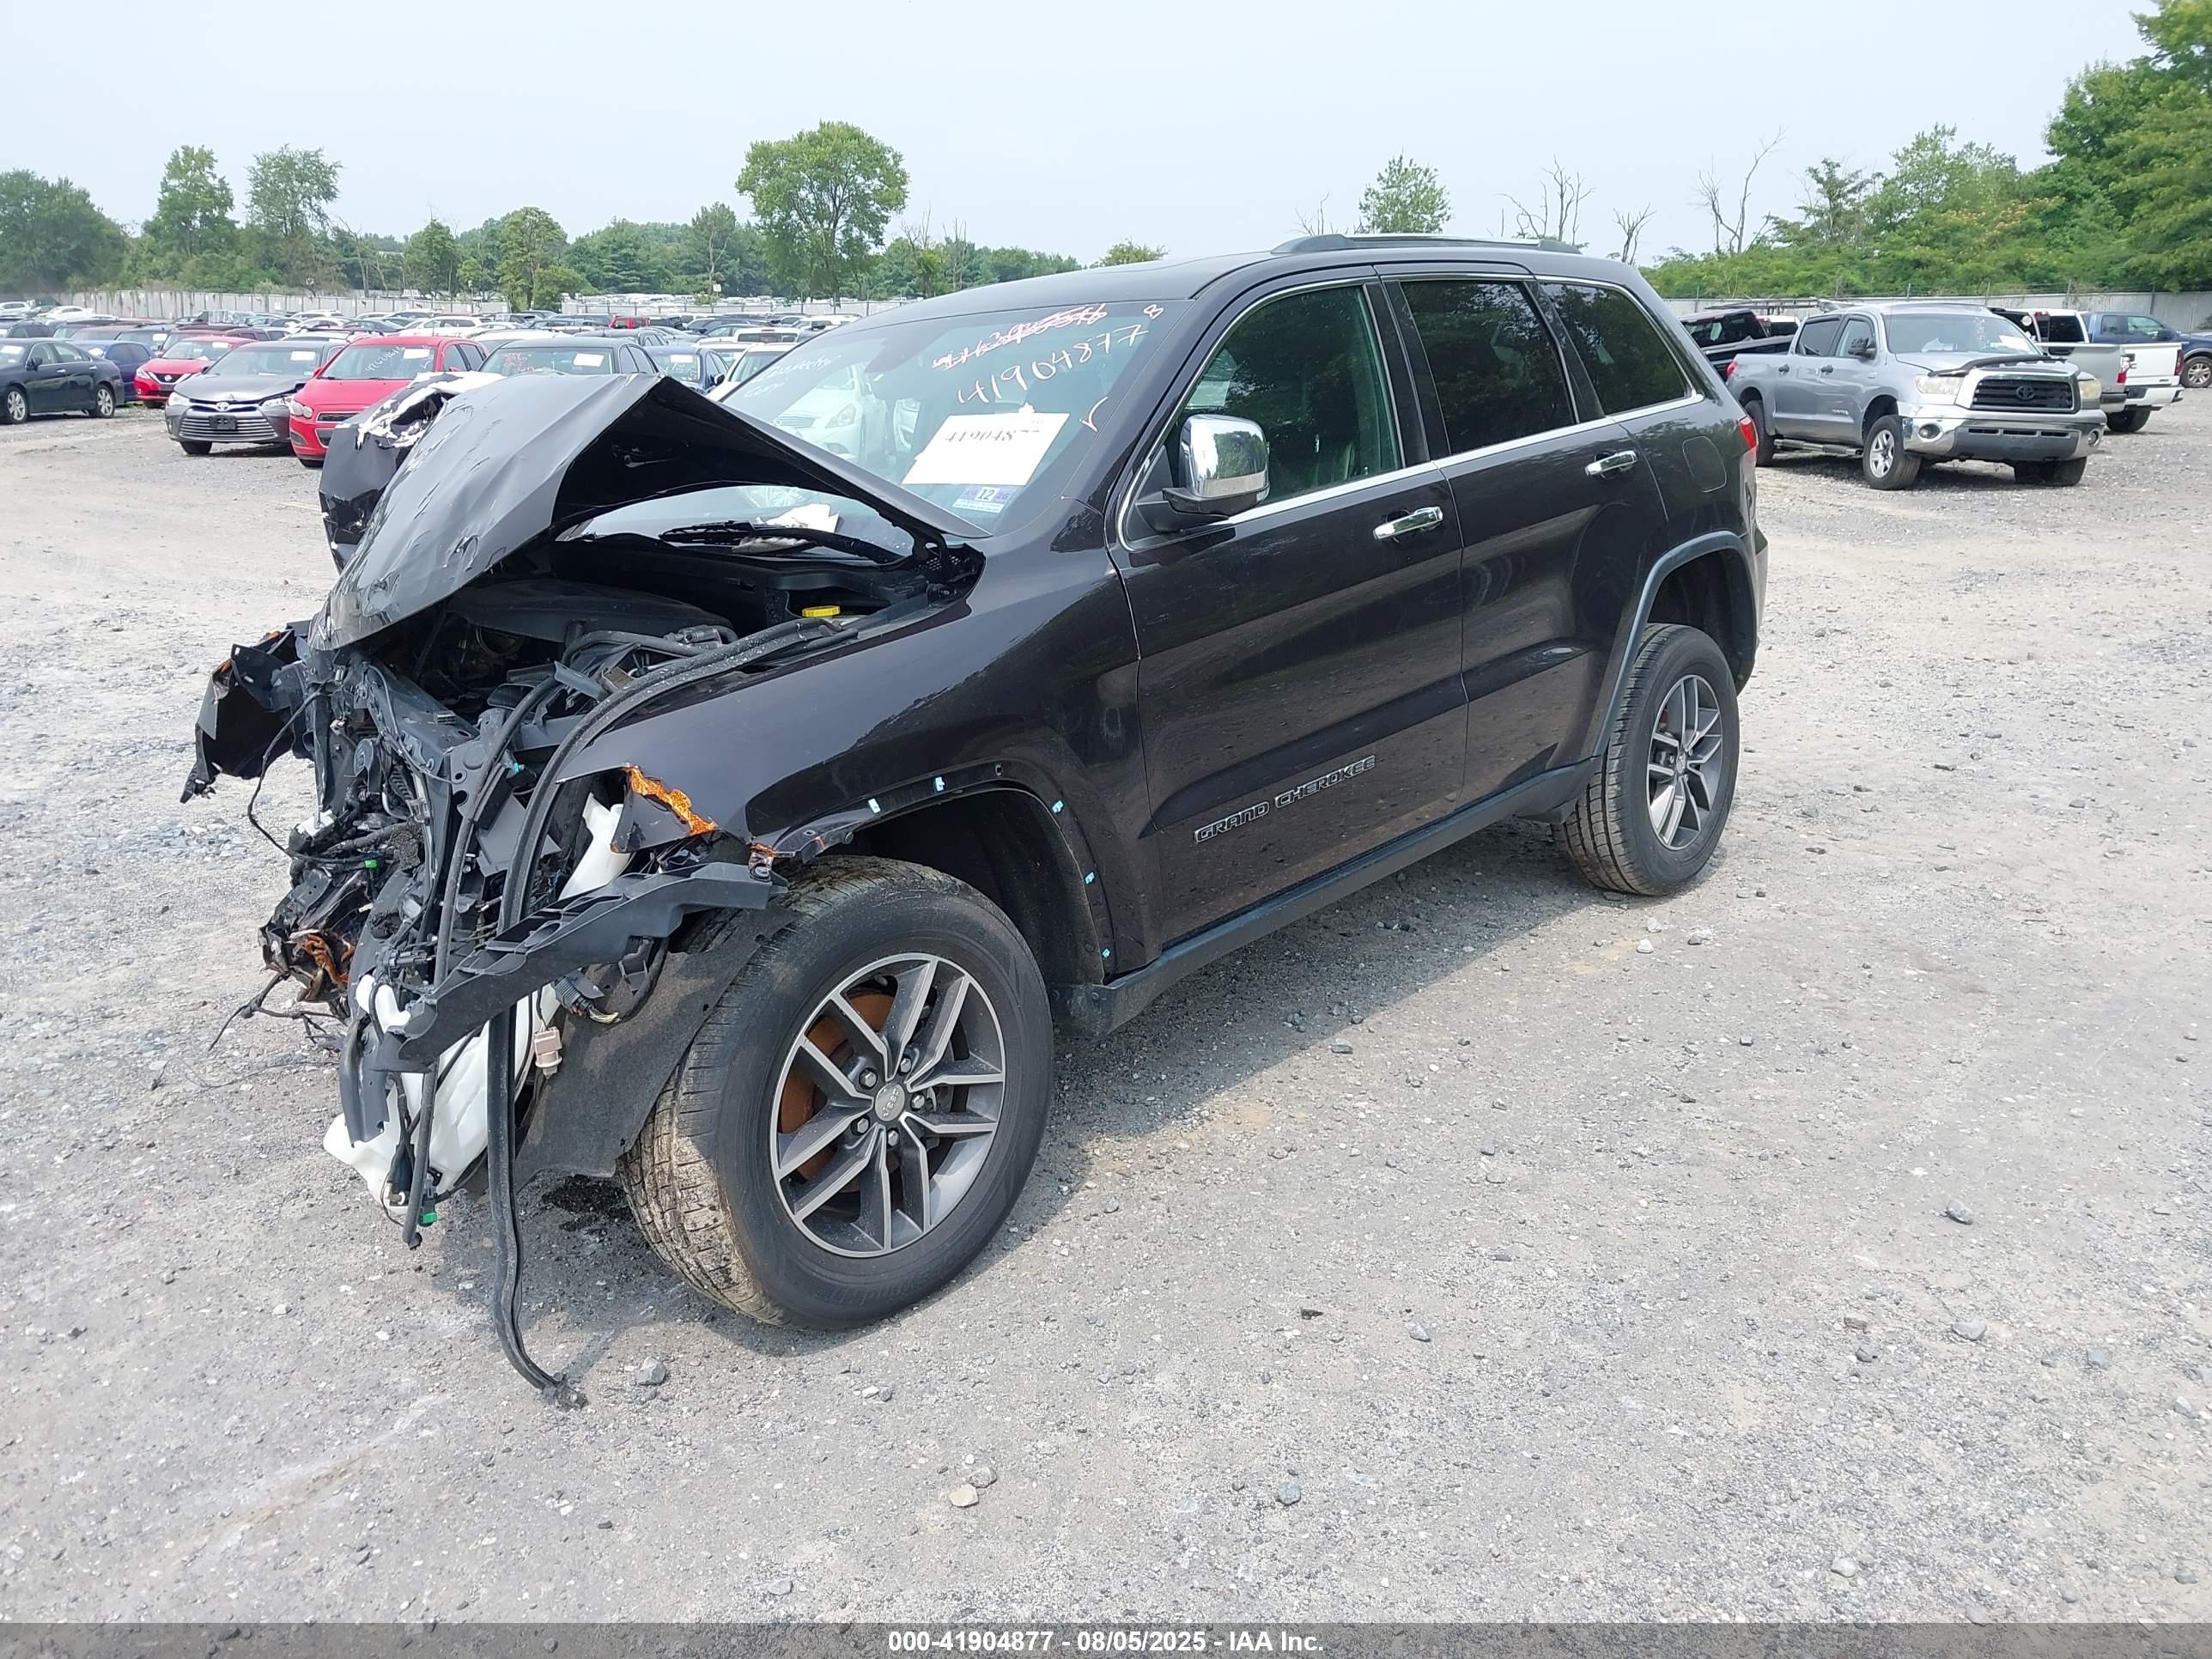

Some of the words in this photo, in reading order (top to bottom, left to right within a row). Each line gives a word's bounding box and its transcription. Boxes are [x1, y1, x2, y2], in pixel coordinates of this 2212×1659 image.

[957, 323, 1150, 404] 41904877
[977, 488, 995, 500] 12
[1194, 800, 1270, 844] GRAND
[1274, 755, 1376, 809] CHEROKEE
